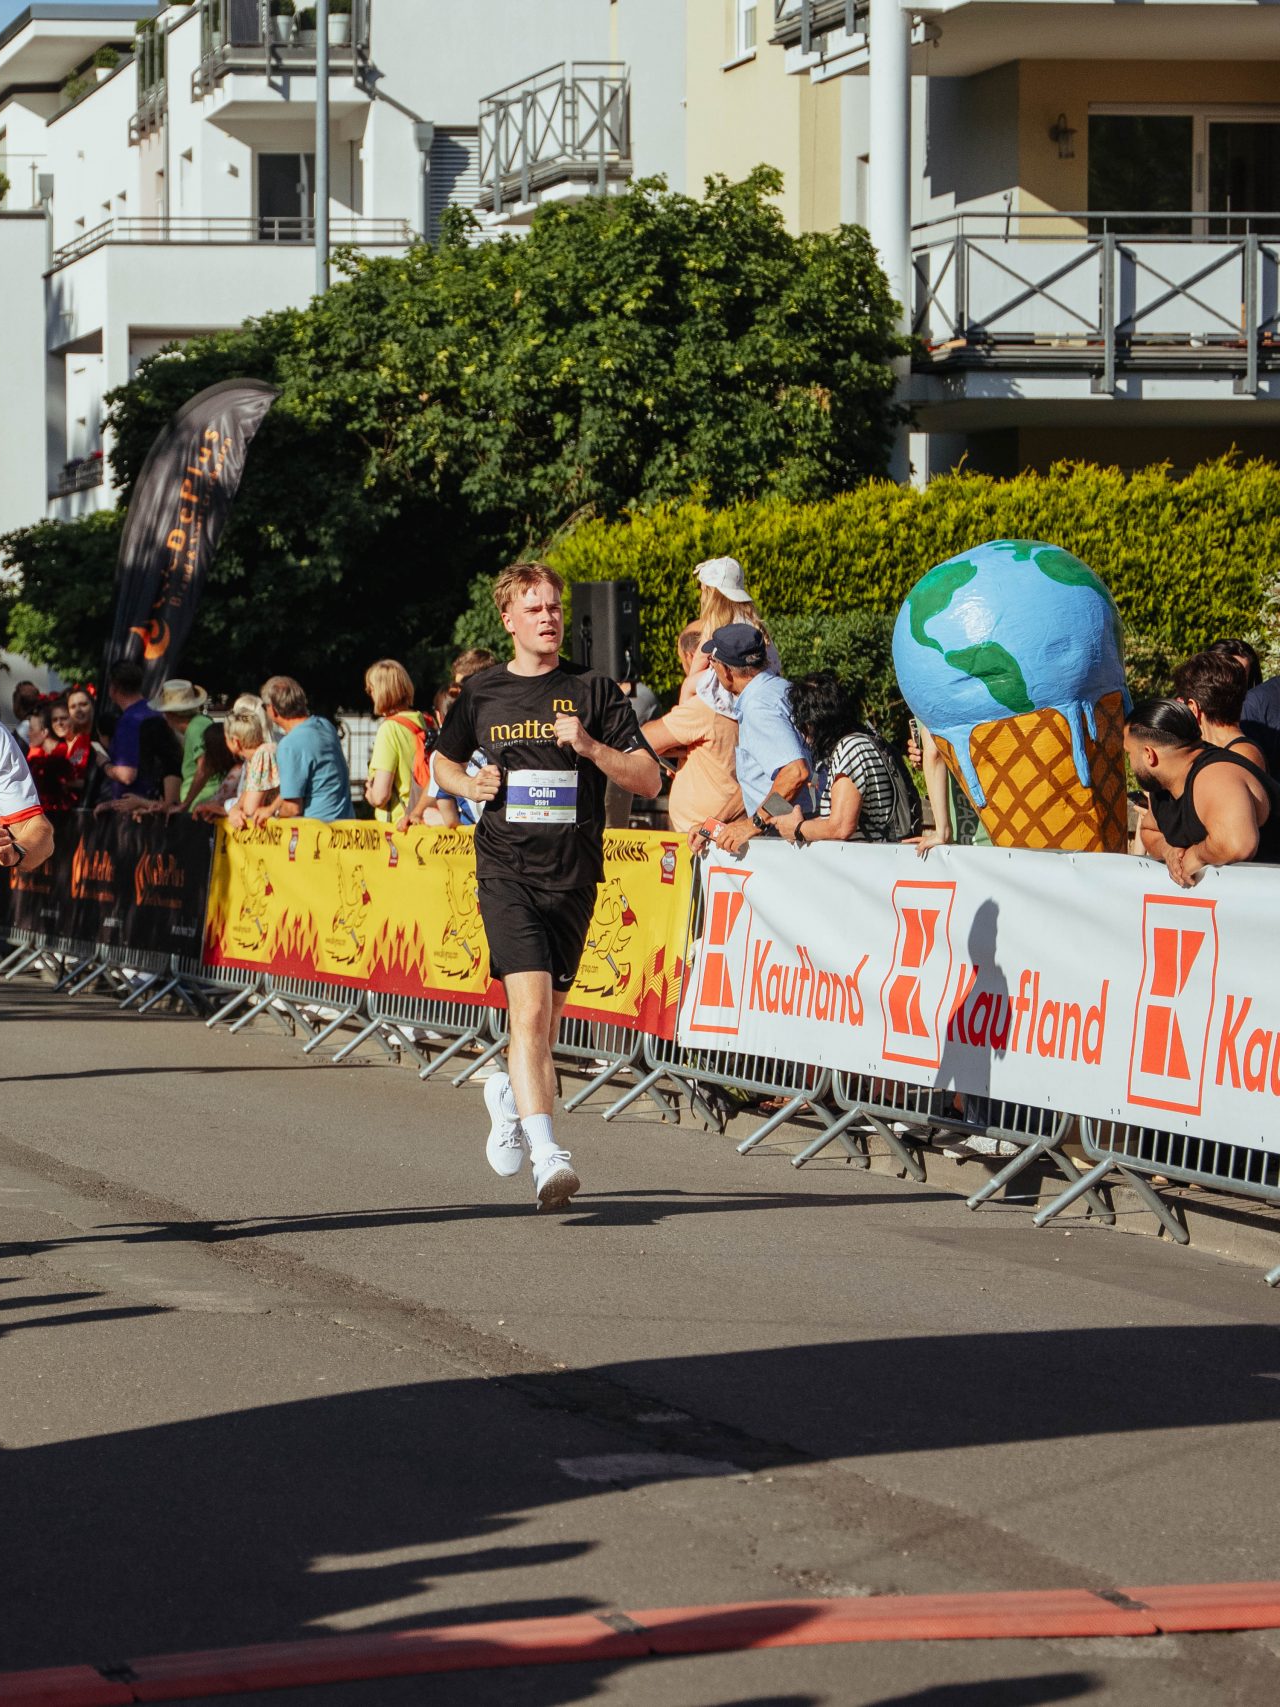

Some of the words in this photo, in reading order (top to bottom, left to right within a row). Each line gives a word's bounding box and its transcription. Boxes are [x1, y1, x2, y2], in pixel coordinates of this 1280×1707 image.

[490, 720, 555, 742] matte
[528, 786, 557, 798] Colin
[749, 939, 869, 1027] Kaufland
[947, 963, 1110, 1066] Kaufland
